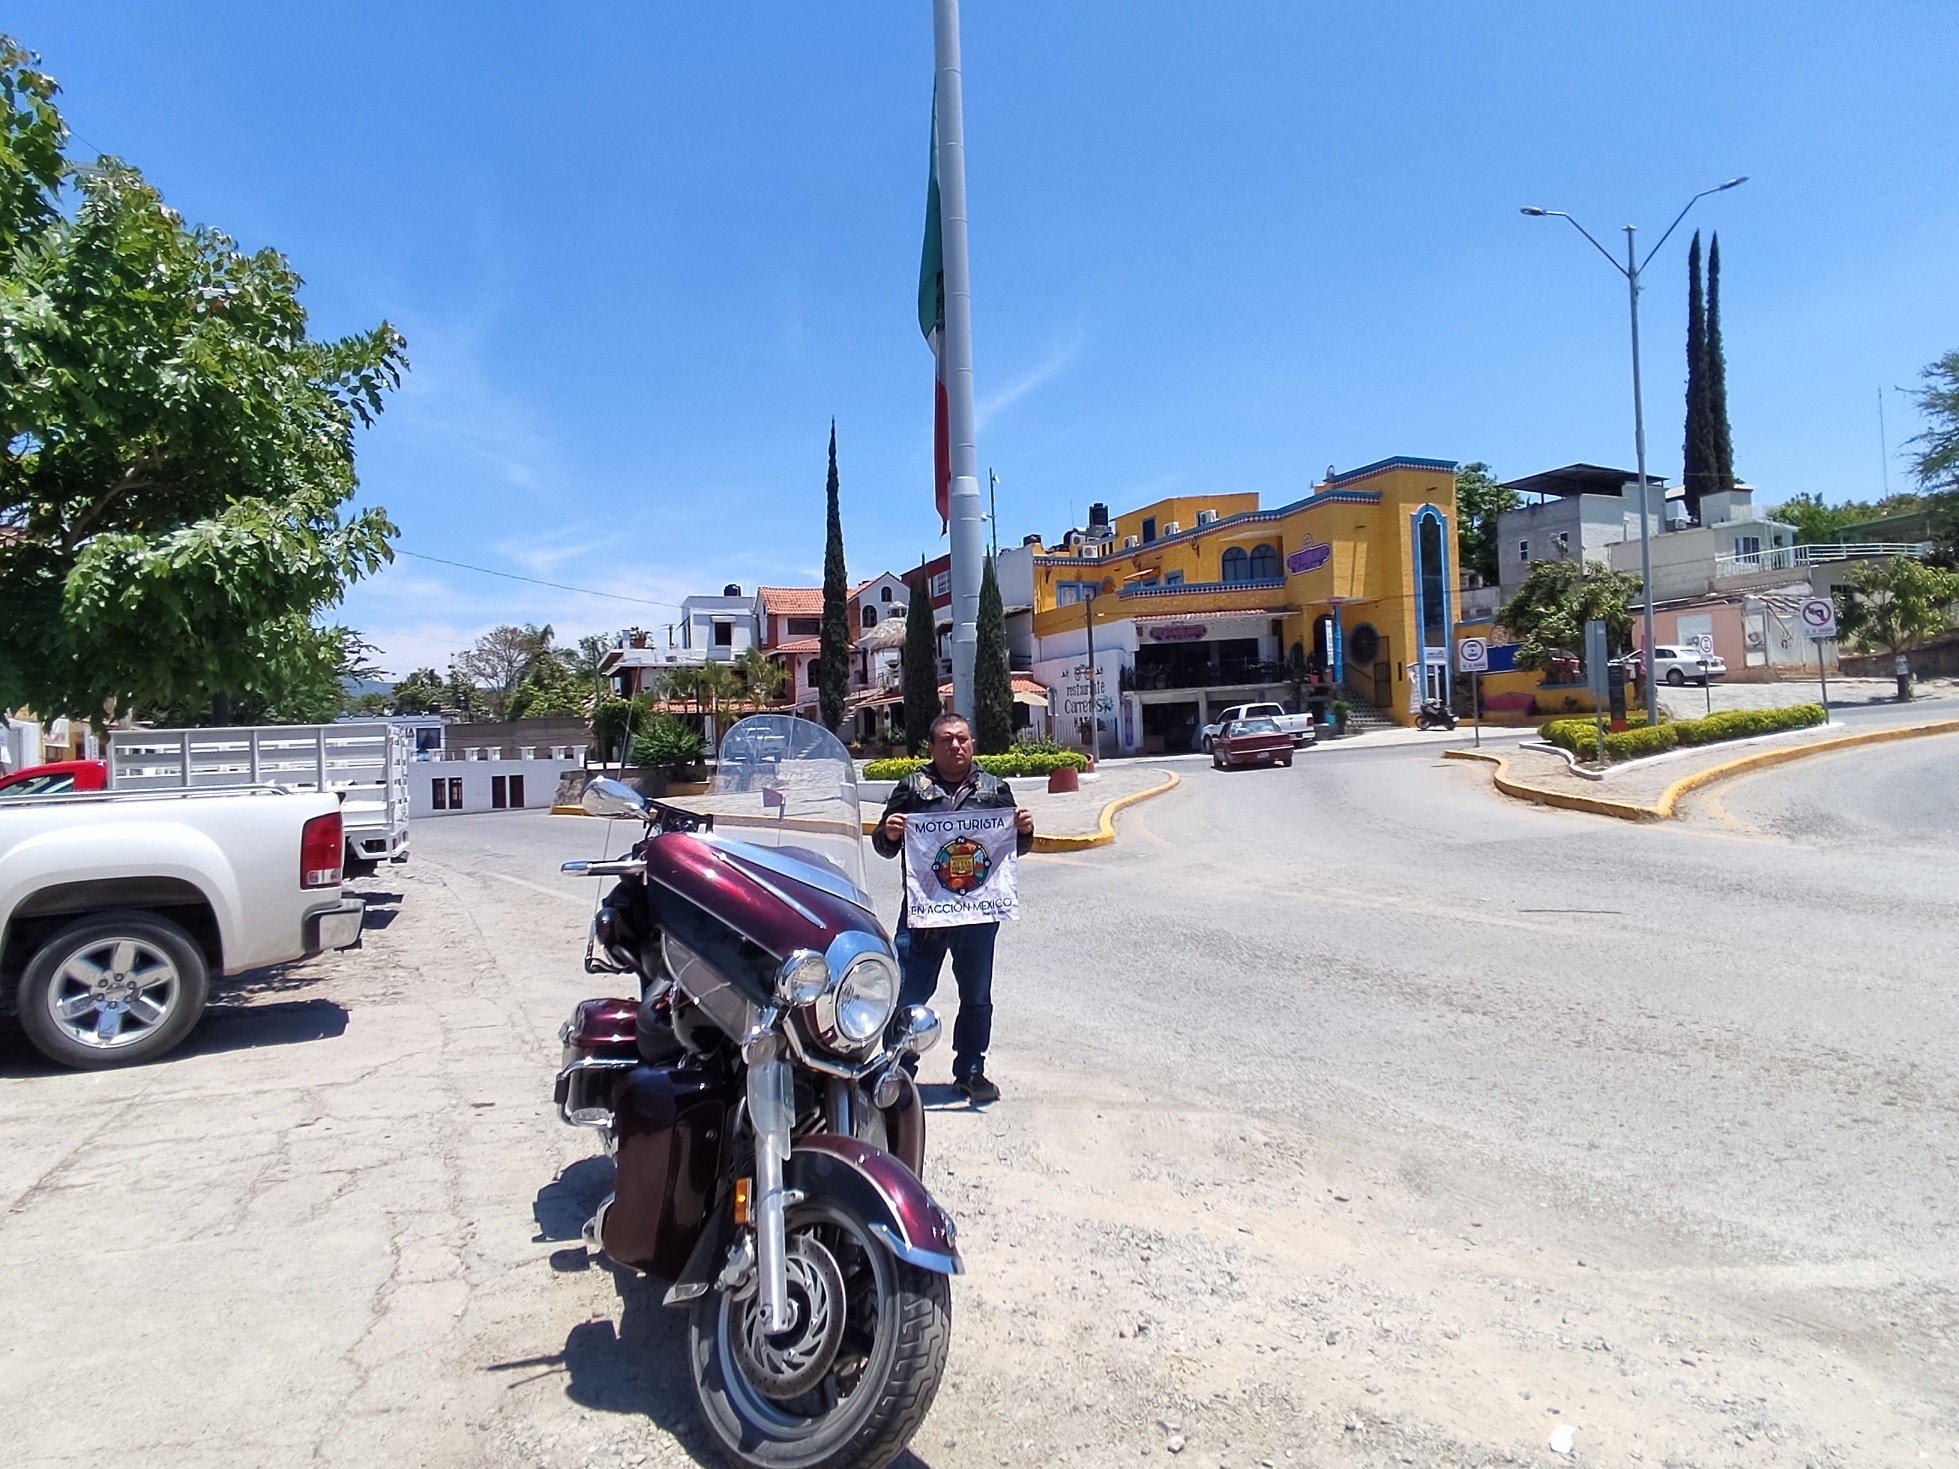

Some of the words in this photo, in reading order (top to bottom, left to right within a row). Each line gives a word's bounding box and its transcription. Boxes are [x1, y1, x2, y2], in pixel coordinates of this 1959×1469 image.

[1066, 681, 1105, 696] restaurnte
[915, 821, 953, 833] MOTO
[957, 818, 1004, 830] TURISTA
[911, 906, 925, 916] EN
